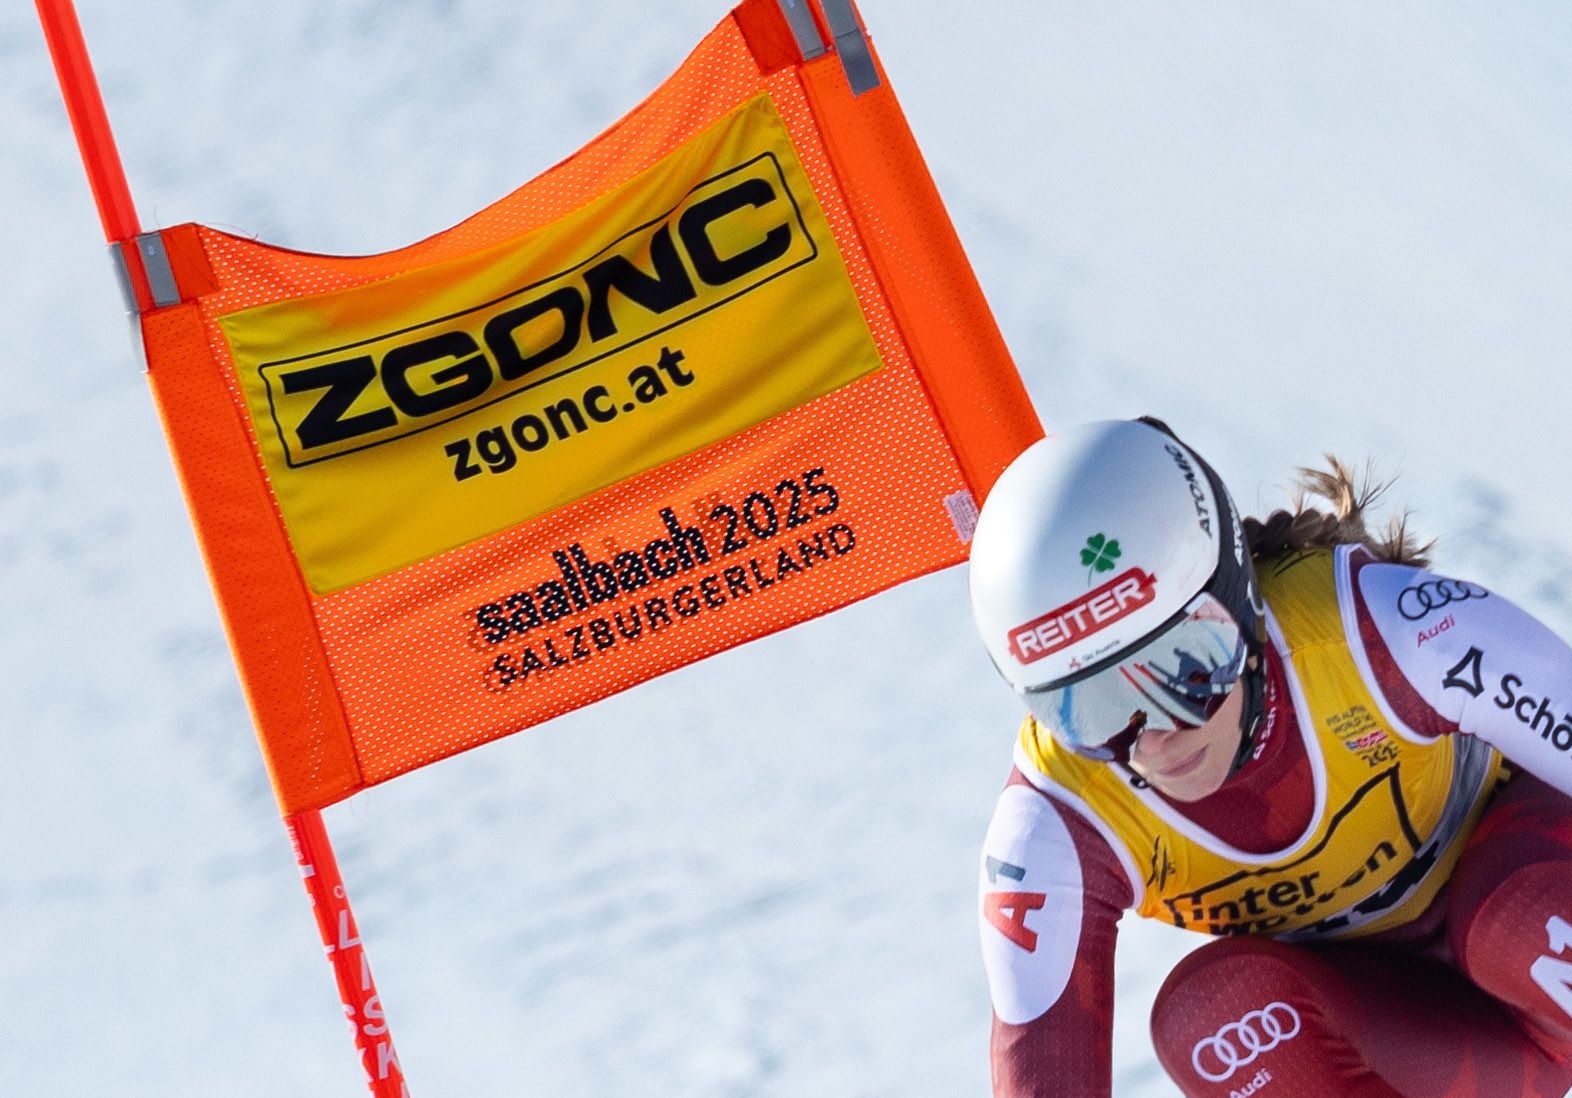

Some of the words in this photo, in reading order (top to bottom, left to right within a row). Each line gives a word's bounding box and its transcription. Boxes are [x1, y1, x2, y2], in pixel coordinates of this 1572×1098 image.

[281, 178, 791, 450] ZGONC
[444, 345, 695, 481] zgonc.at
[1164, 444, 1212, 539] ATOMIC
[476, 508, 708, 645] saalbach
[714, 468, 839, 555] 2025
[492, 524, 858, 689] SALZBURGERLAND
[1016, 577, 1146, 657] REITER
[1416, 615, 1456, 647] Audi
[984, 855, 1047, 954] A1
